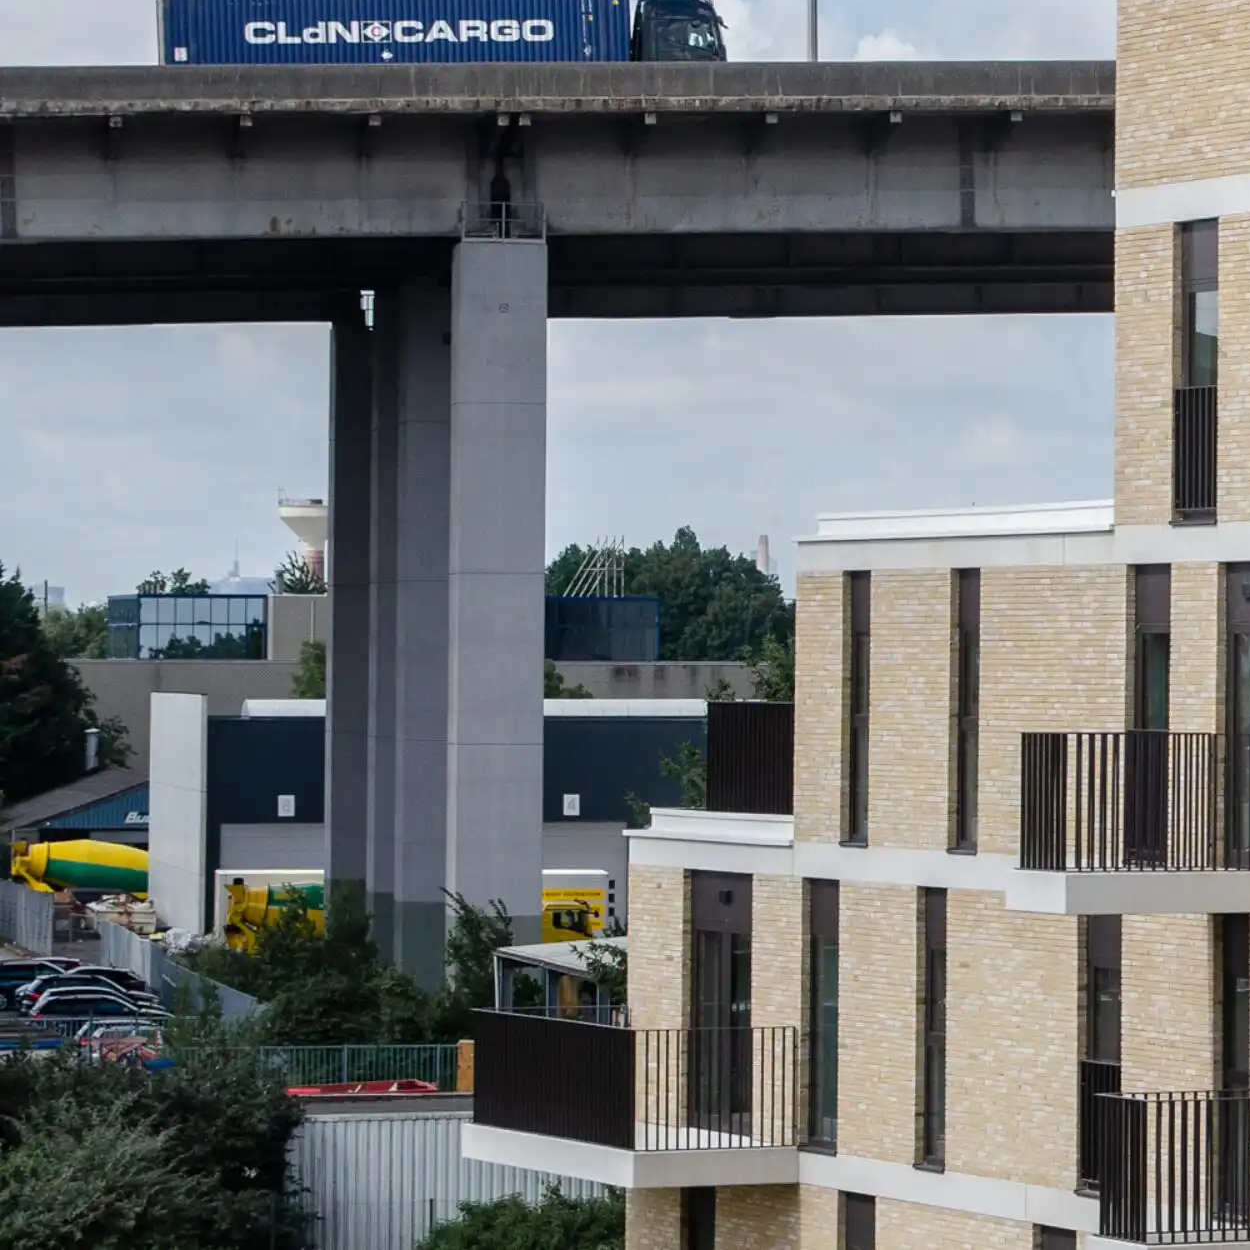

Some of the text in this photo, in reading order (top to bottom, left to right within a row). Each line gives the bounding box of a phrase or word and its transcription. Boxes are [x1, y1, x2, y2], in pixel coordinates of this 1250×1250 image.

[244, 21, 360, 44] CLdN
[393, 19, 554, 43] CARGO
[567, 797, 576, 811] 4
